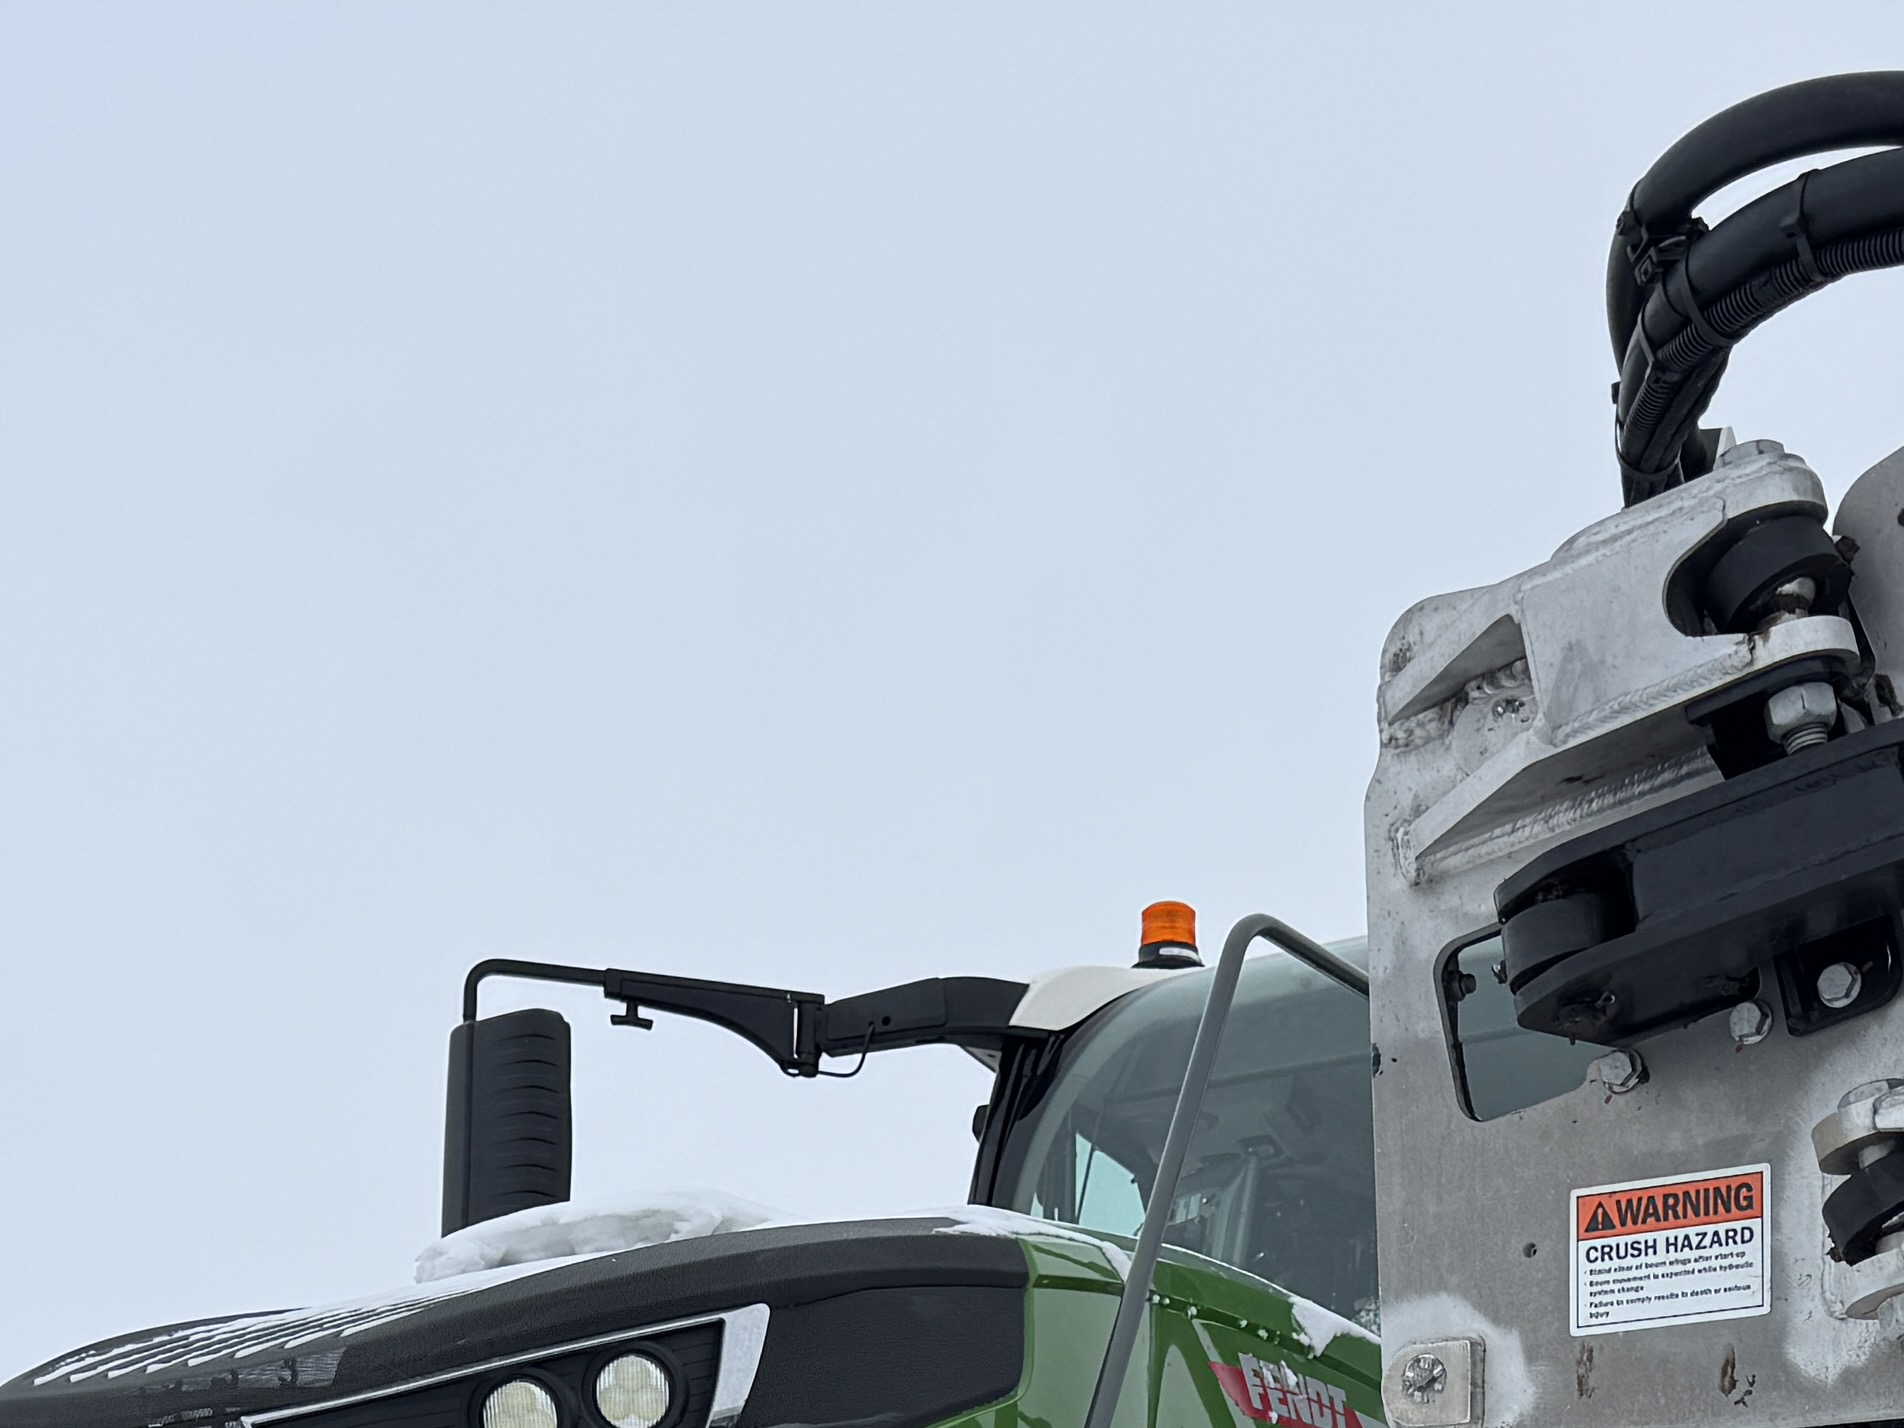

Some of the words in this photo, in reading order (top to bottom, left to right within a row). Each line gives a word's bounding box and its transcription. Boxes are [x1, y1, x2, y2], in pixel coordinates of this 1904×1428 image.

[1615, 1182, 1754, 1228] WARNING
[1585, 1238, 1657, 1264] CRUSH
[1665, 1226, 1755, 1255] HAZARD
[1626, 1296, 1652, 1305] comply
